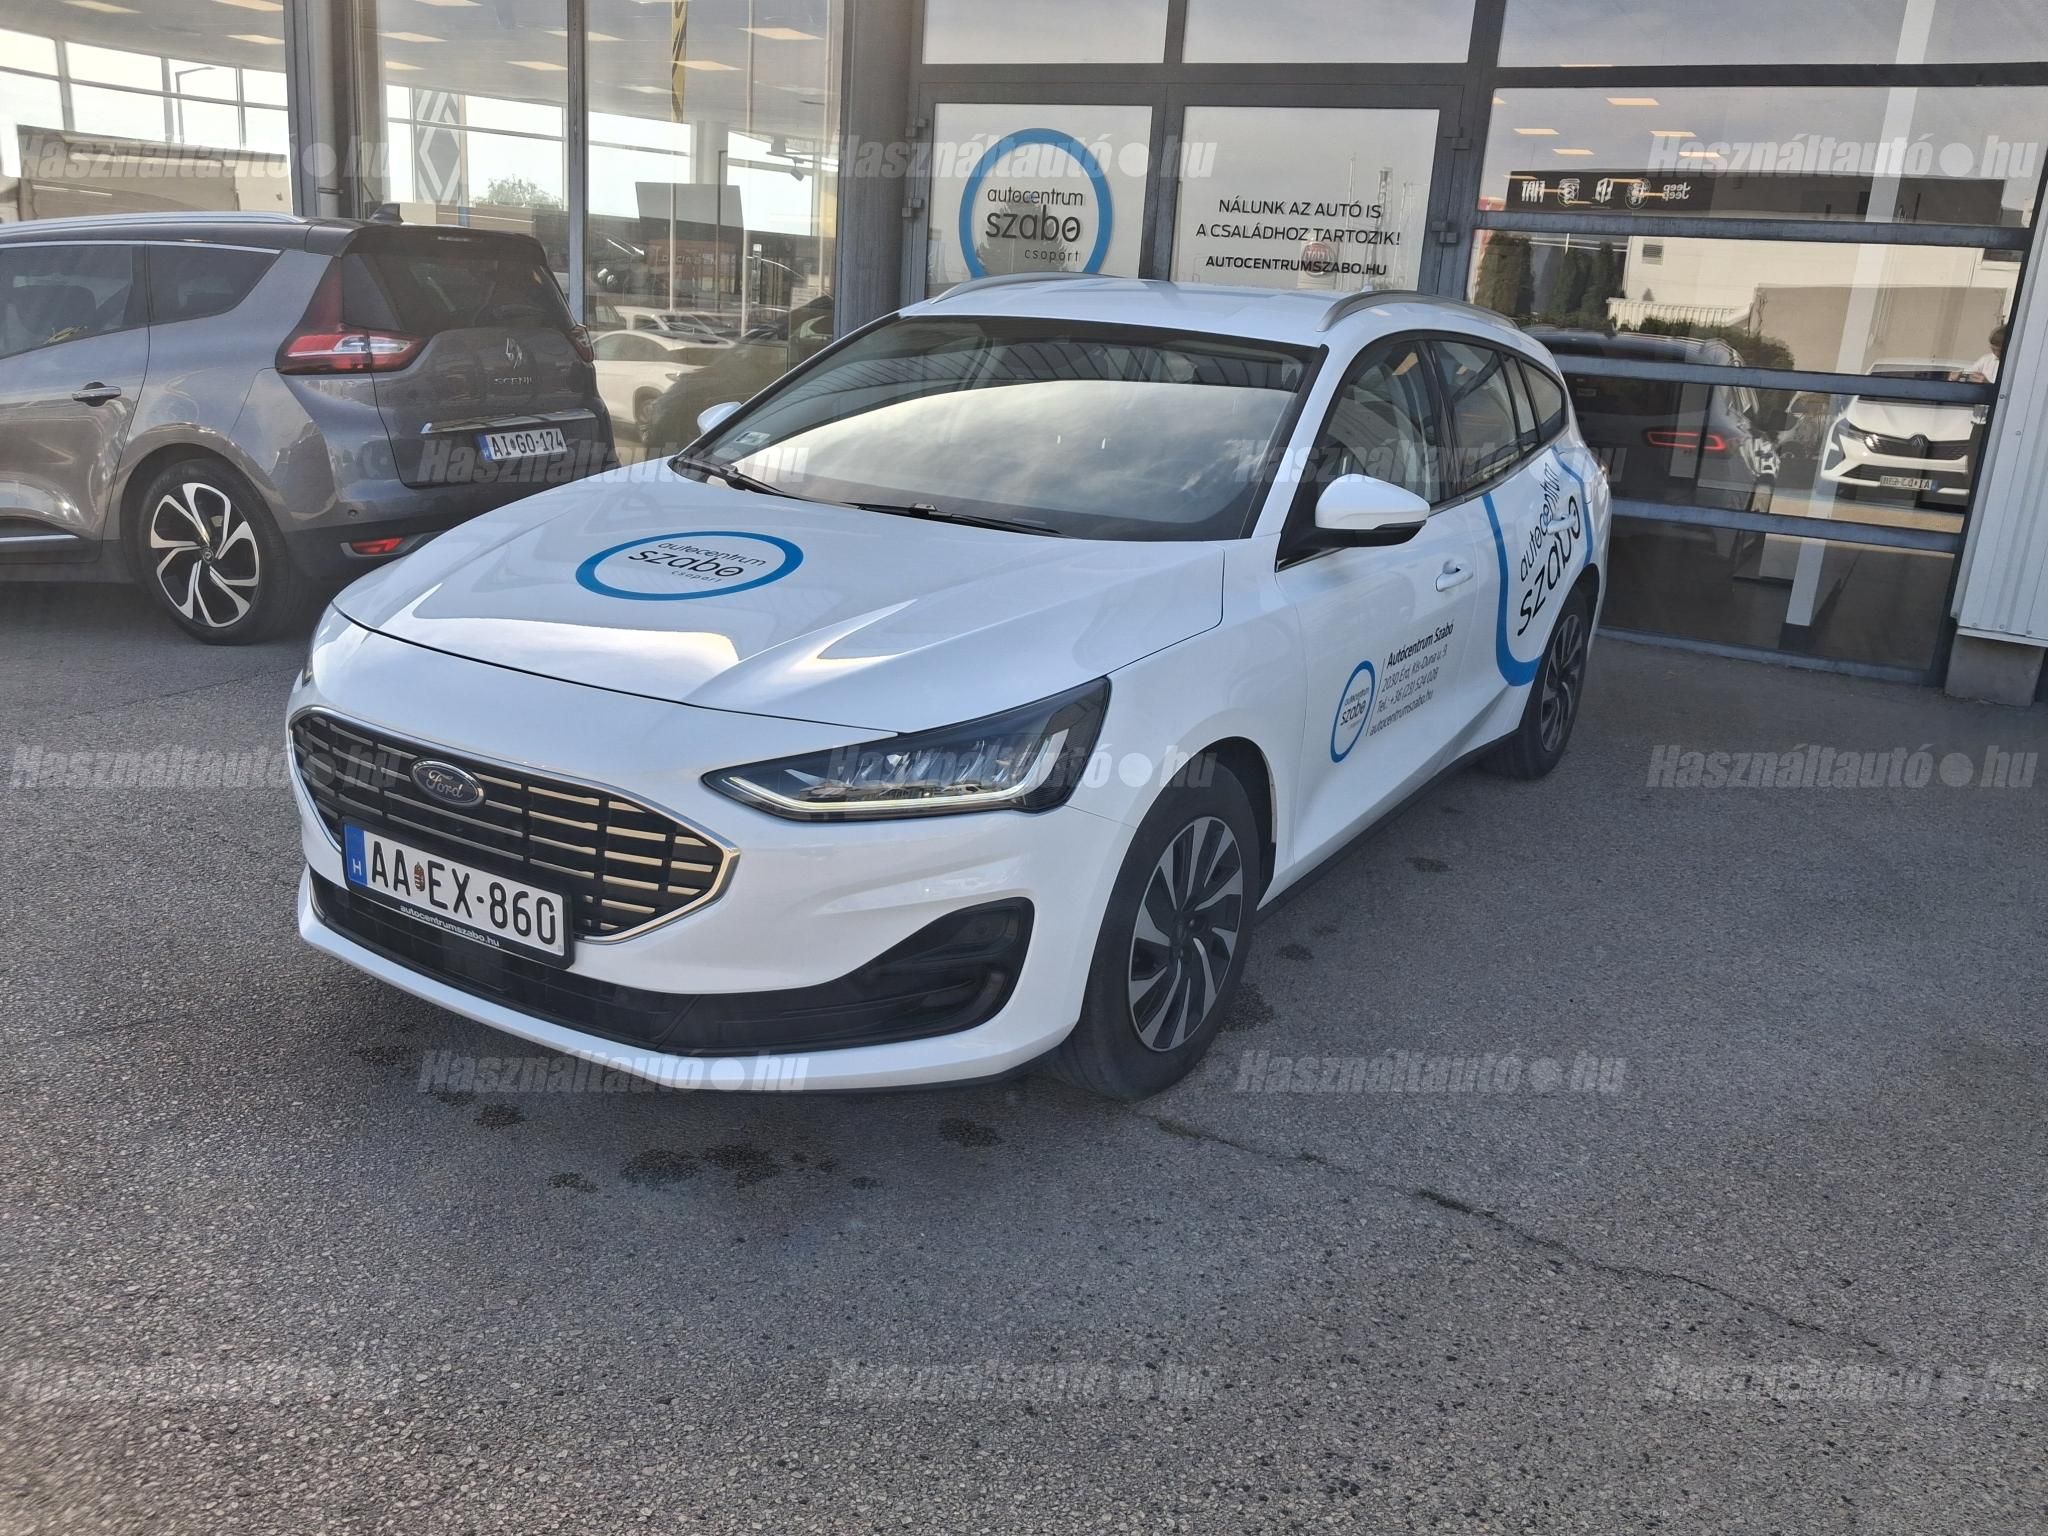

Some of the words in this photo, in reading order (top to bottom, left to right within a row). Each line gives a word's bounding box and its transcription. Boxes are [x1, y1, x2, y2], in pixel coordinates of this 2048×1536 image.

[987, 186, 1083, 206] autocentrum
[1218, 195, 1285, 215] NÁLUNK
[1289, 202, 1312, 216] AZ
[1314, 200, 1362, 218] AUTÓ
[1366, 204, 1382, 219] IS
[1195, 223, 1207, 237] A
[1210, 222, 1309, 241] CSALÁDHOZ
[1313, 228, 1401, 245] TARTOZIK!
[1024, 249, 1080, 264] csoport
[1206, 255, 1388, 276] AUTOCENTRUMSZABO.HU
[658, 542, 767, 567] autocentrum
[426, 770, 464, 798] Ford
[352, 857, 362, 876] H
[399, 905, 500, 948] autocentrumszabo.hu
